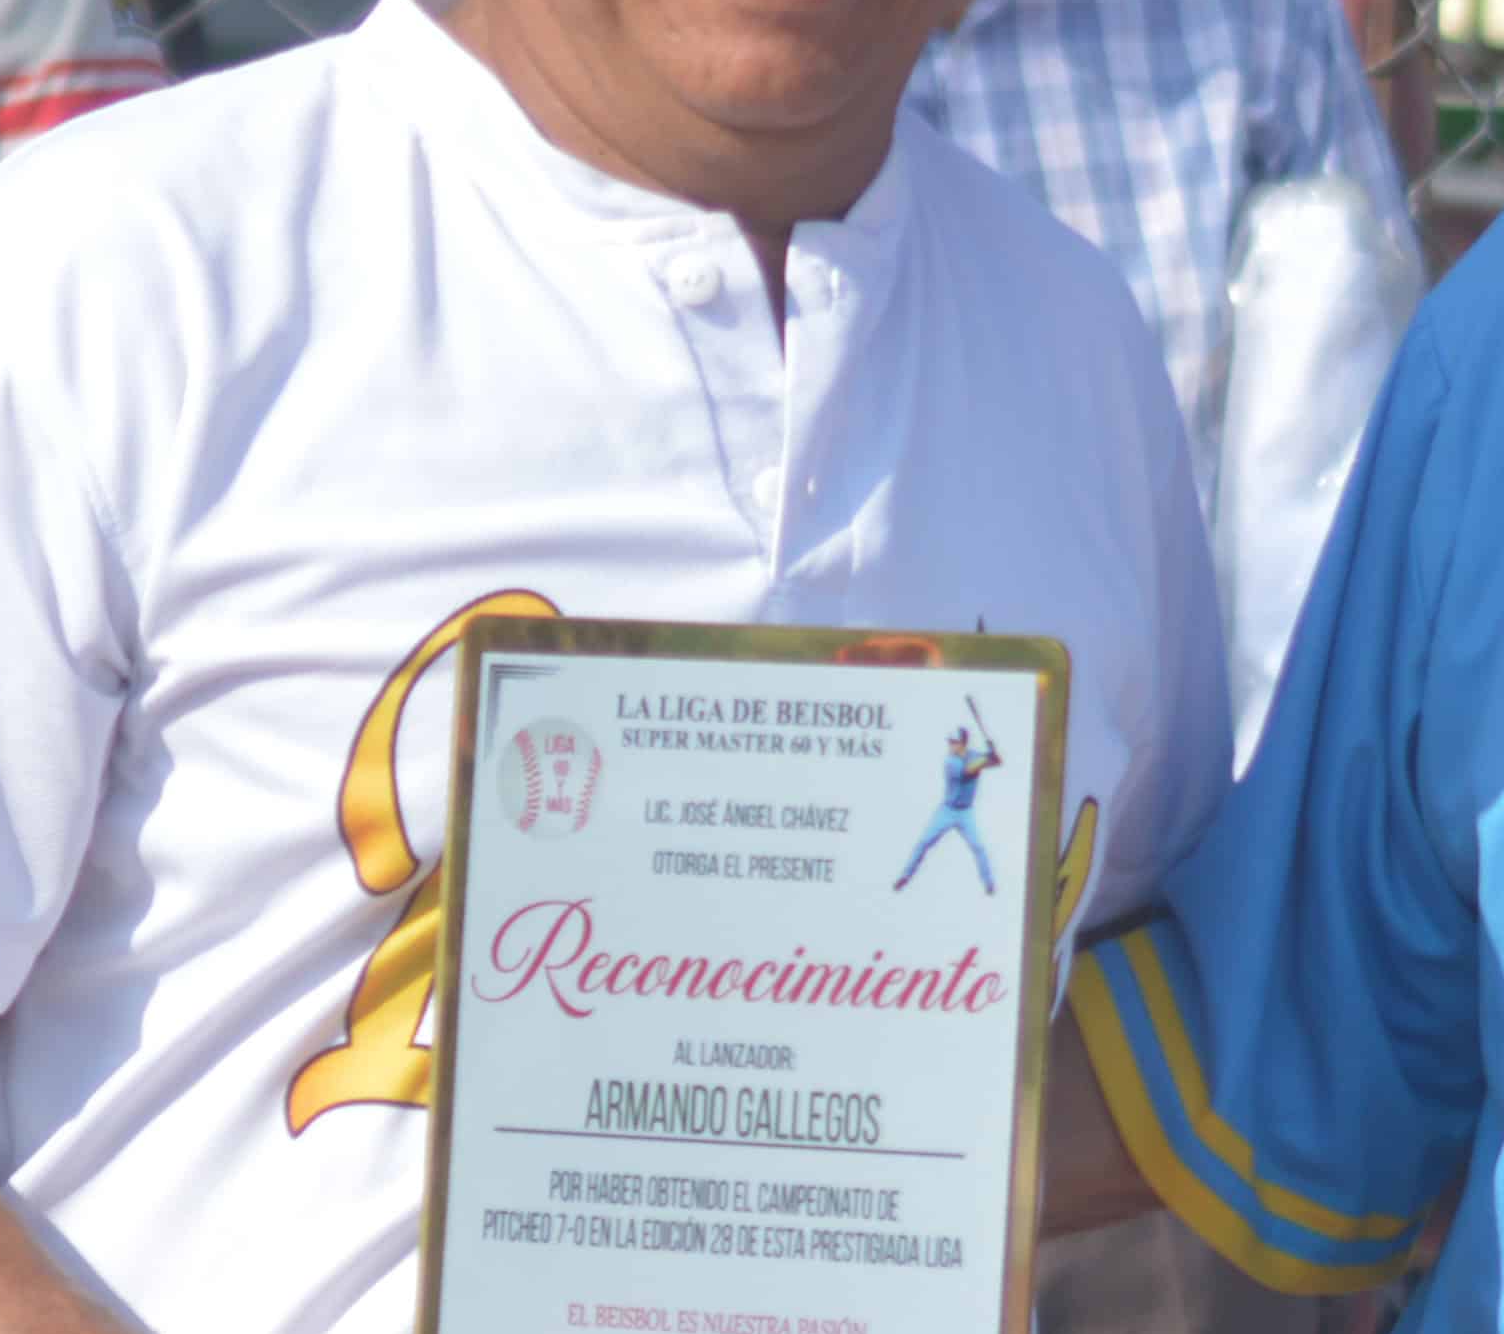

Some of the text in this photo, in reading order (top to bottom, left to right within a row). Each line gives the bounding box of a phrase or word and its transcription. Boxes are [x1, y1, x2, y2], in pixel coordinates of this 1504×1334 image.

[616, 693, 893, 730] LA LIGA DE BEISBOL
[621, 727, 884, 759] SUPER MASTER 60 Y MÁS
[644, 796, 851, 833] LIC. JOSÉ ÁNGEL CHÁVEZ
[652, 850, 835, 883] OTORGA EL PRESENTE
[471, 897, 1008, 1018] Reconocimiento
[673, 1039, 797, 1072] AL LANZADOR:
[585, 1079, 882, 1145] ARMANDO GALLEGOS
[549, 1170, 901, 1221] POR HABER OBTENIDO EL CAMPEONATO DE
[482, 1209, 552, 1244] PITCHEO
[556, 1214, 586, 1246] 7-0
[589, 1216, 612, 1248] EN
[615, 1218, 637, 1250] LA
[642, 1216, 707, 1253] EDICIÓN
[736, 1224, 759, 1257] DE
[761, 1226, 806, 1260] ESTA
[808, 1229, 920, 1267] PRESTIGIADA
[924, 1235, 963, 1268] LIGA
[567, 1303, 589, 1327] EL
[594, 1304, 671, 1332] BEISBOL
[676, 1310, 698, 1334] ES
